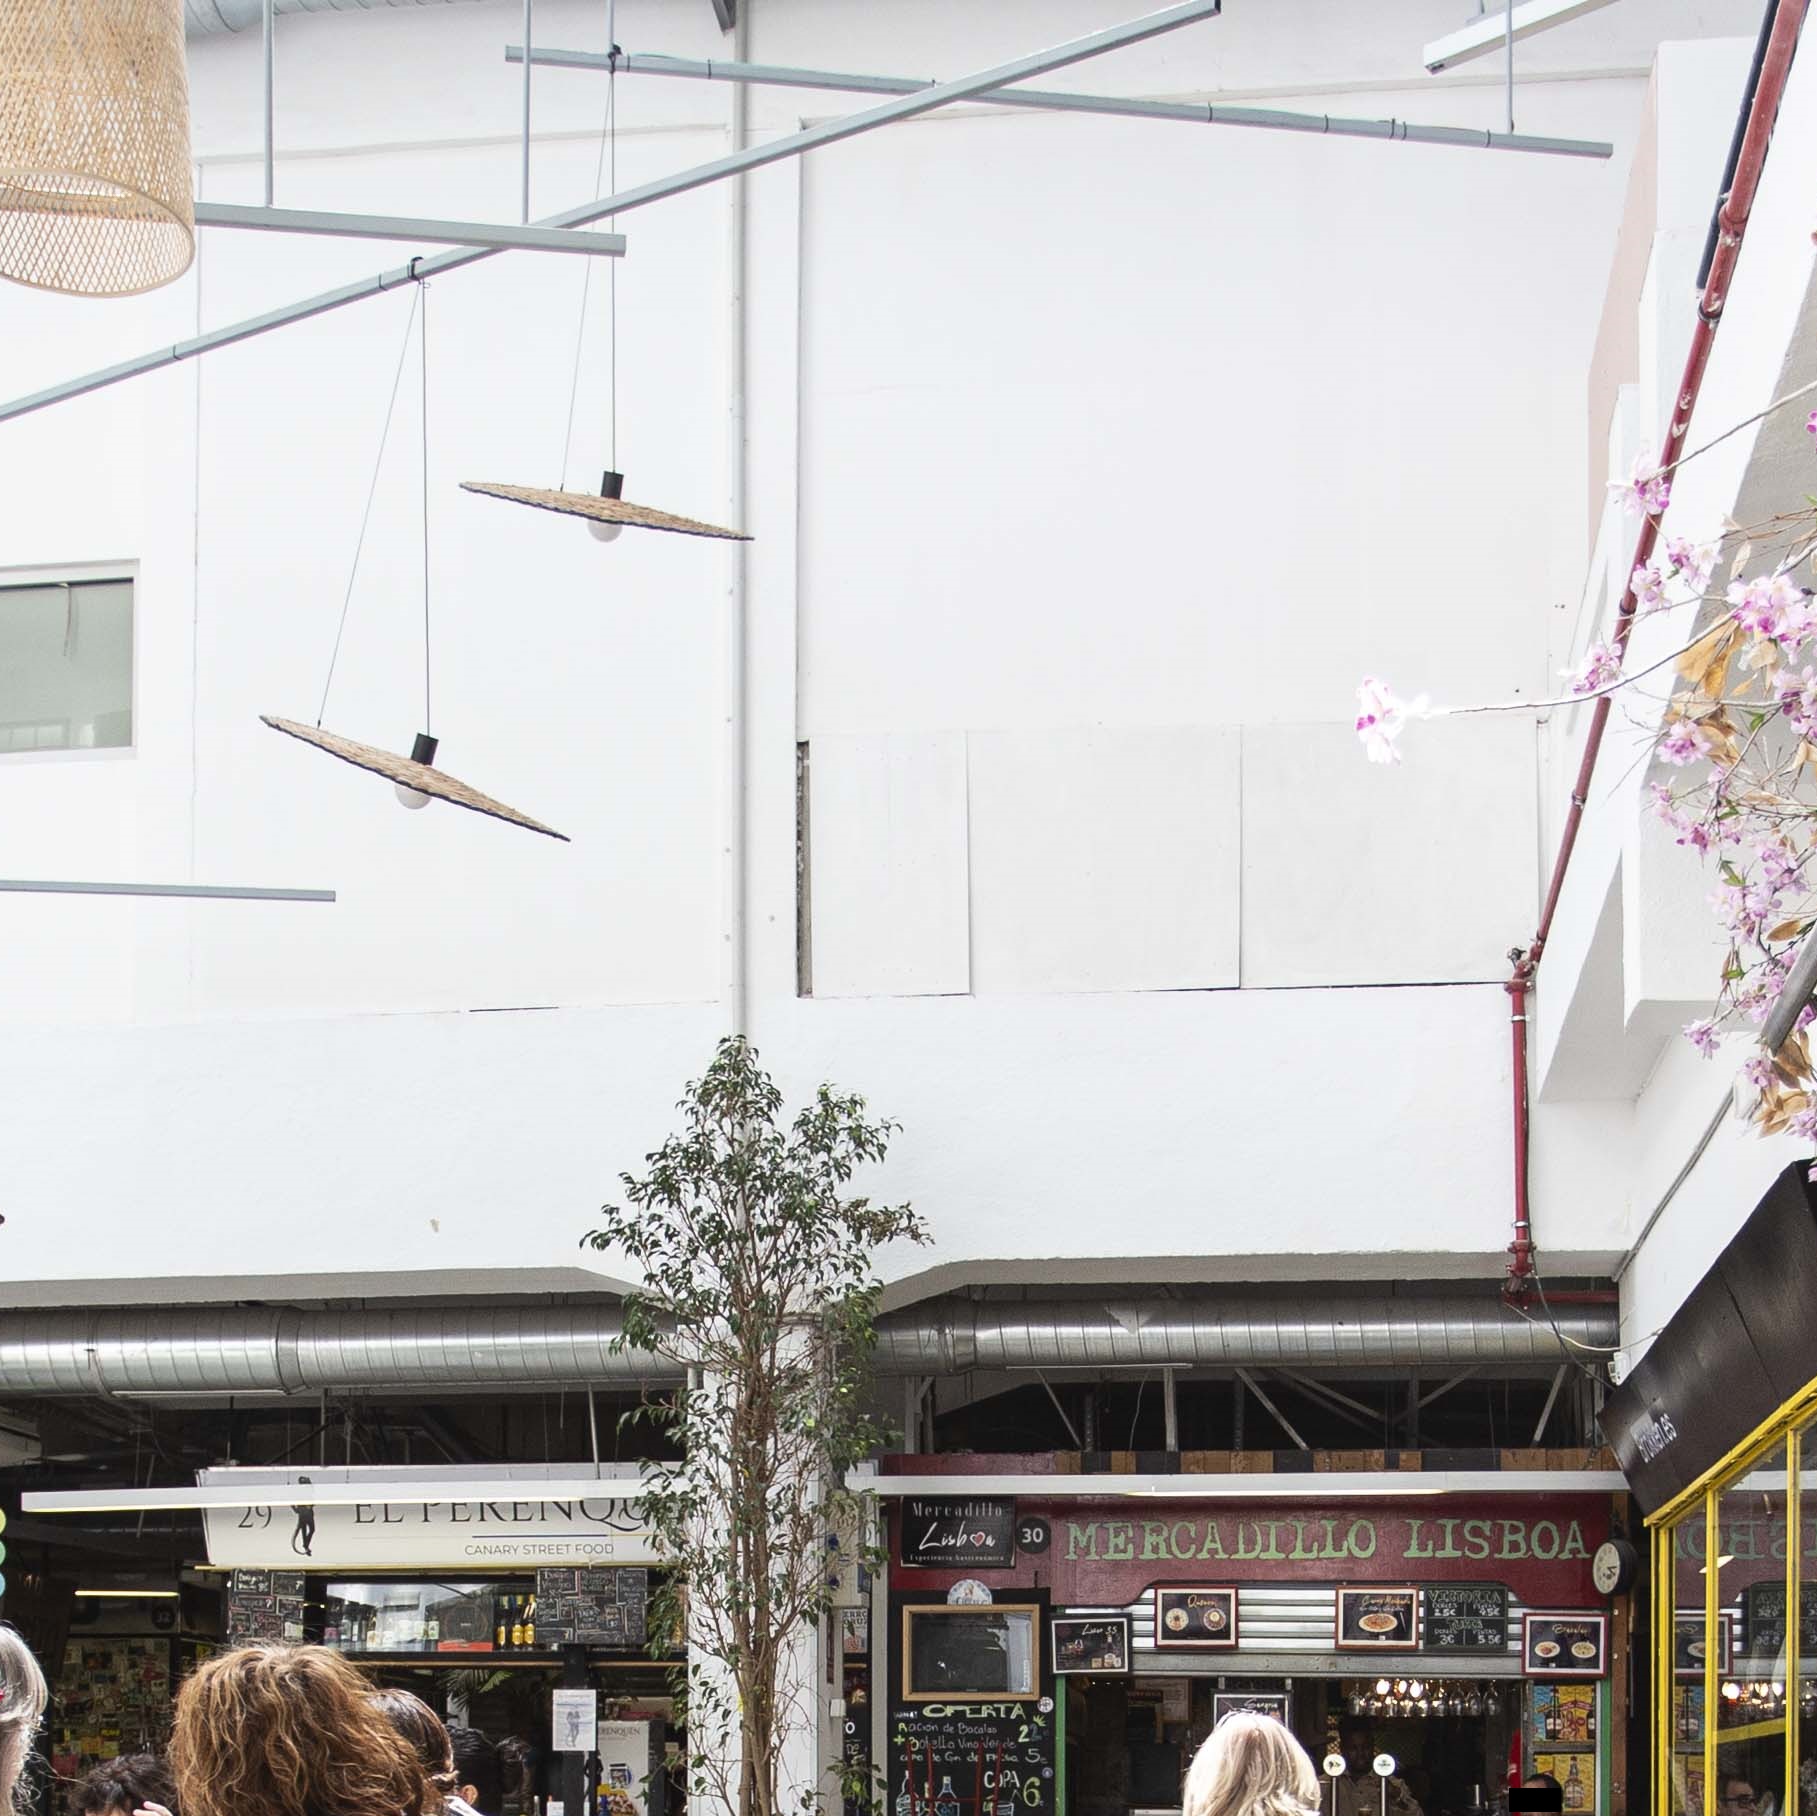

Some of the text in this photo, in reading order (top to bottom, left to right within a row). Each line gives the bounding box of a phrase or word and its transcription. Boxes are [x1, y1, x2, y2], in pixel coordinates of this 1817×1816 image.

[238, 1505, 272, 1529] 29
[913, 1502, 1002, 1518] Mercadillo
[1022, 1528, 1043, 1543] 30
[1064, 1518, 1592, 1561] MERCADILLO LISBOA
[464, 1542, 615, 1555] CANARY STREET FOOD
[922, 1703, 1026, 1720] OFERTA
[943, 1723, 955, 1734] de
[958, 1722, 998, 1735] Bacalao
[958, 1737, 979, 1749] Vino
